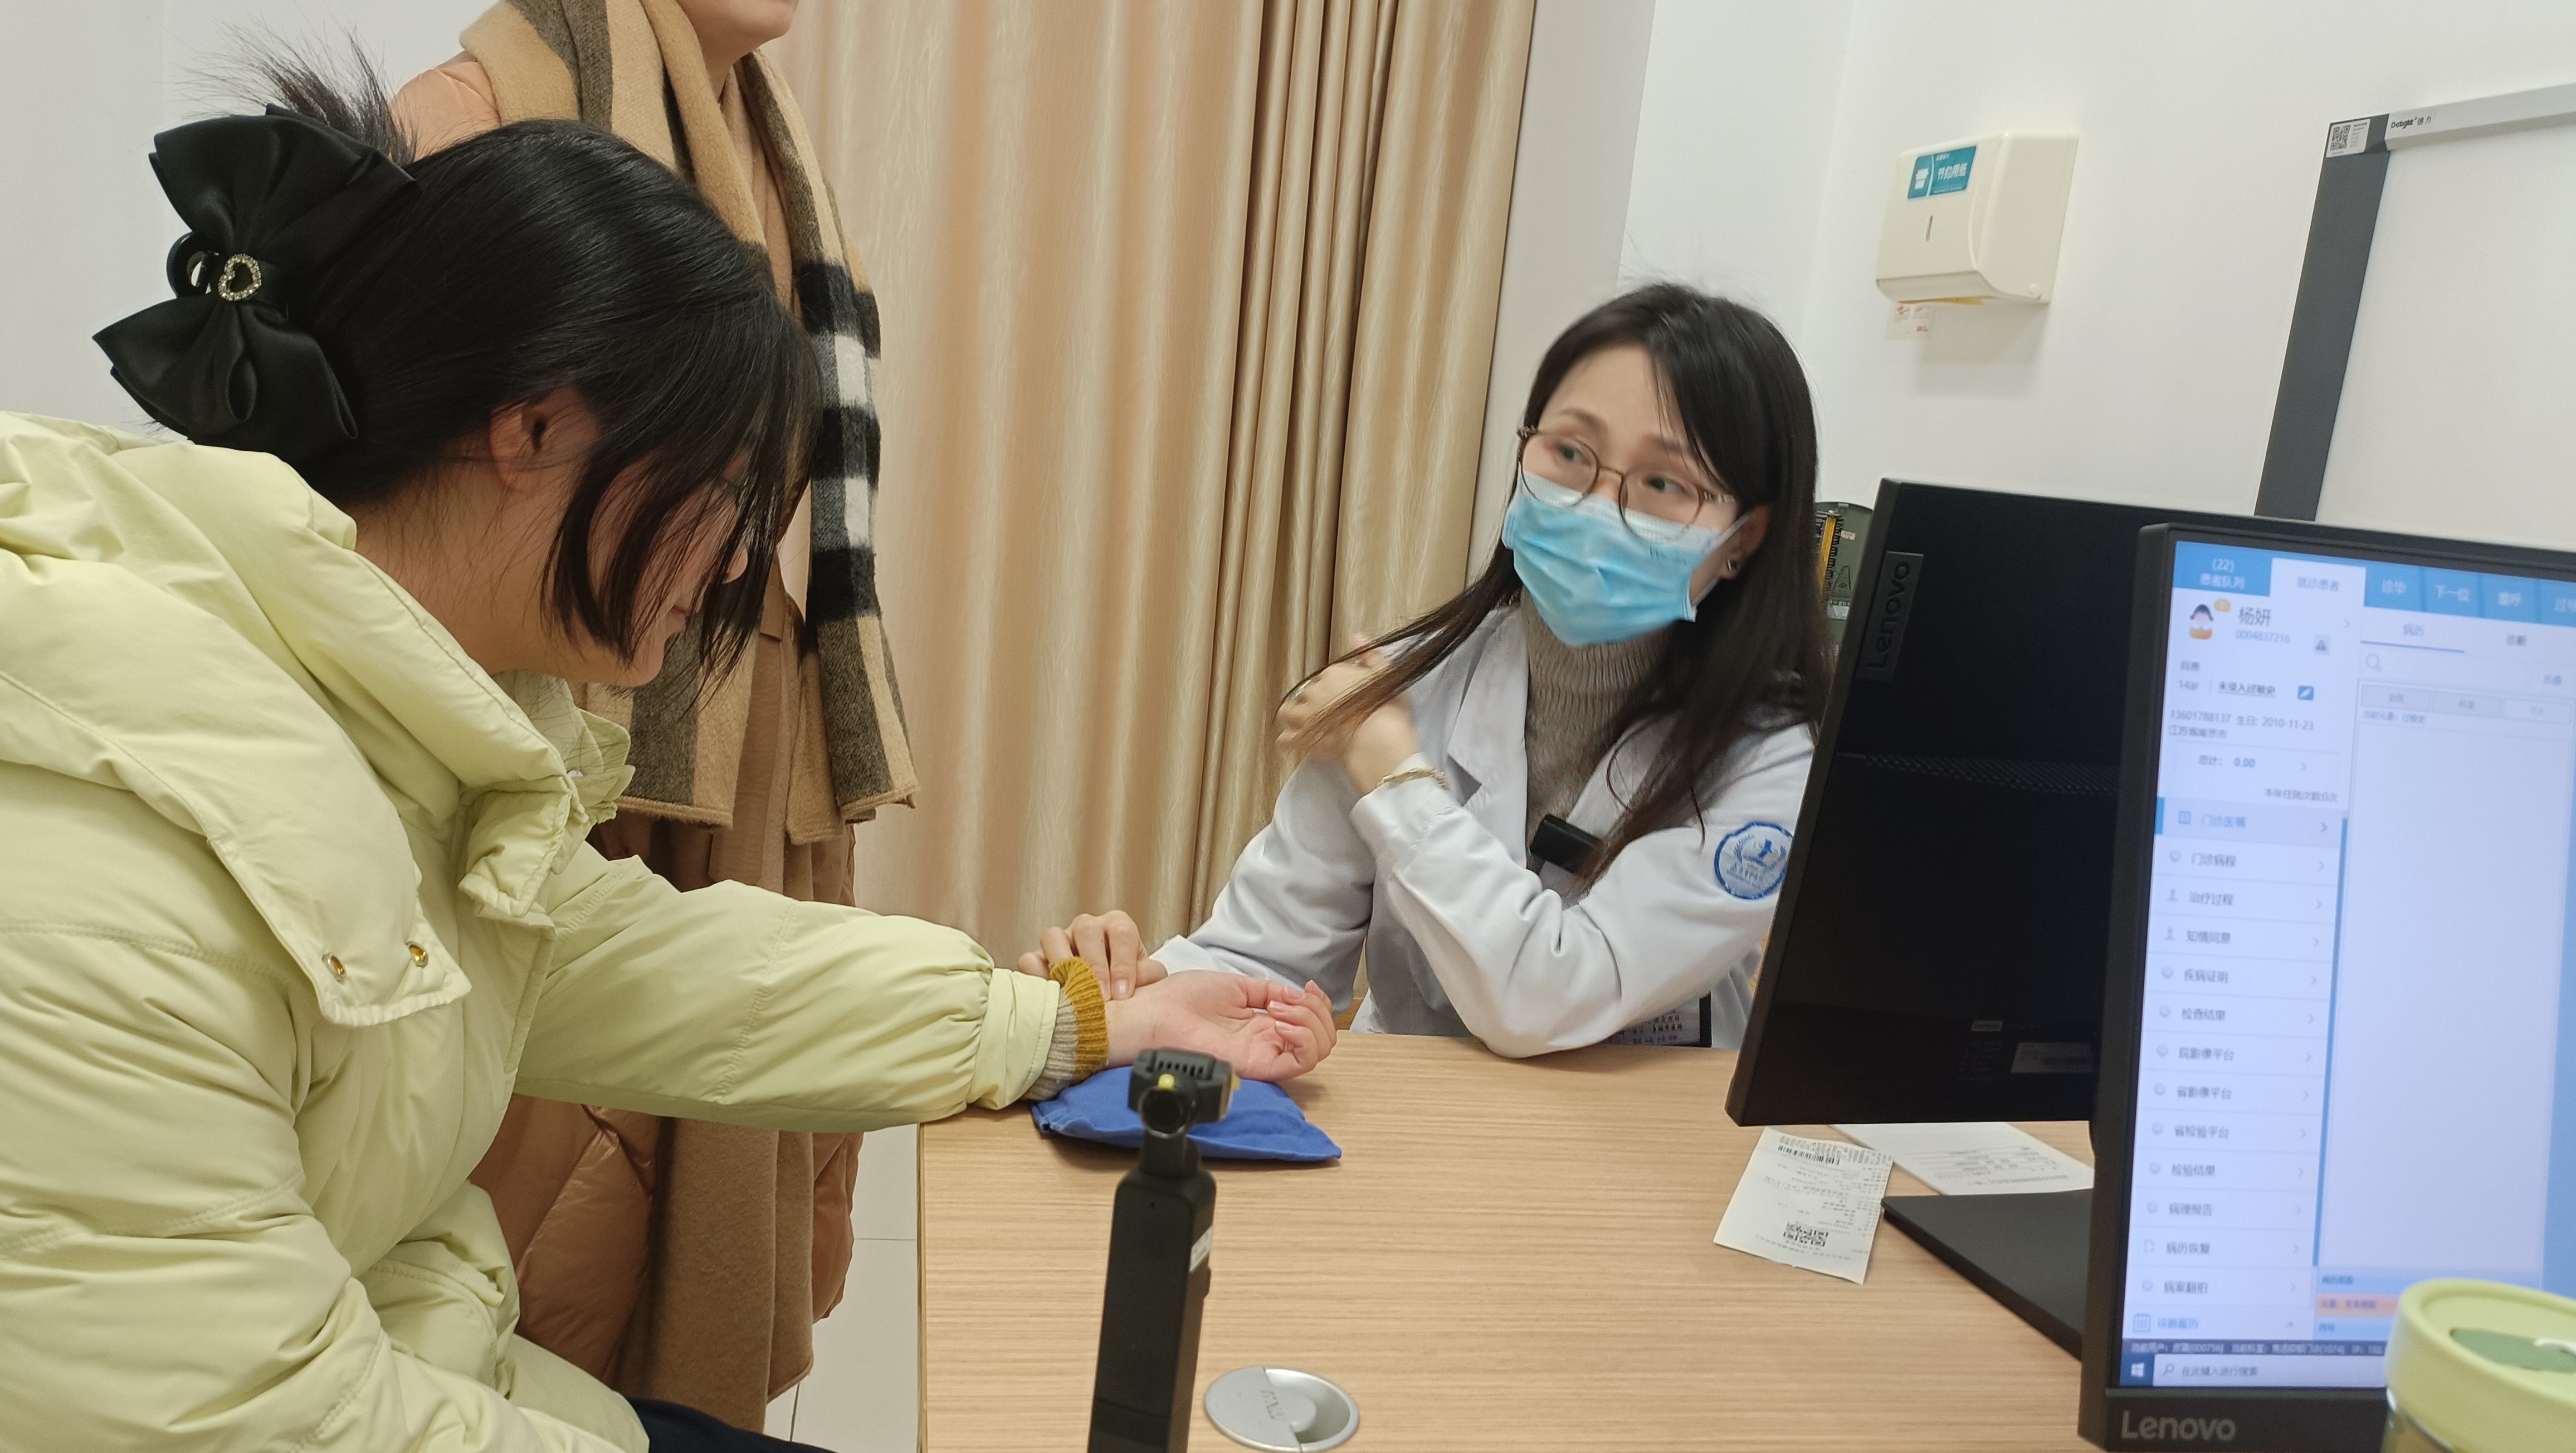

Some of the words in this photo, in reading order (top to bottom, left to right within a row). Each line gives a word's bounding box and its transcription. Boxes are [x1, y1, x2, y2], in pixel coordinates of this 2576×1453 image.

[2212, 558, 2235, 572] (22)
[2199, 573, 2245, 589] 患者队列
[2435, 584, 2470, 602] 下一位
[1867, 561, 1911, 668] Lenovo
[2238, 606, 2271, 626] 杨妍
[2262, 716, 2314, 731] 2010-11-23
[2233, 757, 2256, 768] 0.00
[2191, 852, 2236, 867] 门诊病程
[2188, 891, 2234, 906] 治疗过程
[2186, 929, 2231, 944] 知情同意
[2183, 968, 2228, 983] 疾病证明
[2182, 1007, 2226, 1021] 检查结果
[2174, 1124, 2229, 1139] 省检验平台
[2172, 1163, 2216, 1177] 检验结果
[2169, 1202, 2212, 1216] 病理报告
[2166, 1242, 2210, 1255] 病历恢复
[2182, 1366, 2258, 1377] 在此键入进行搜索
[2121, 1410, 2237, 1441] Lenovo
